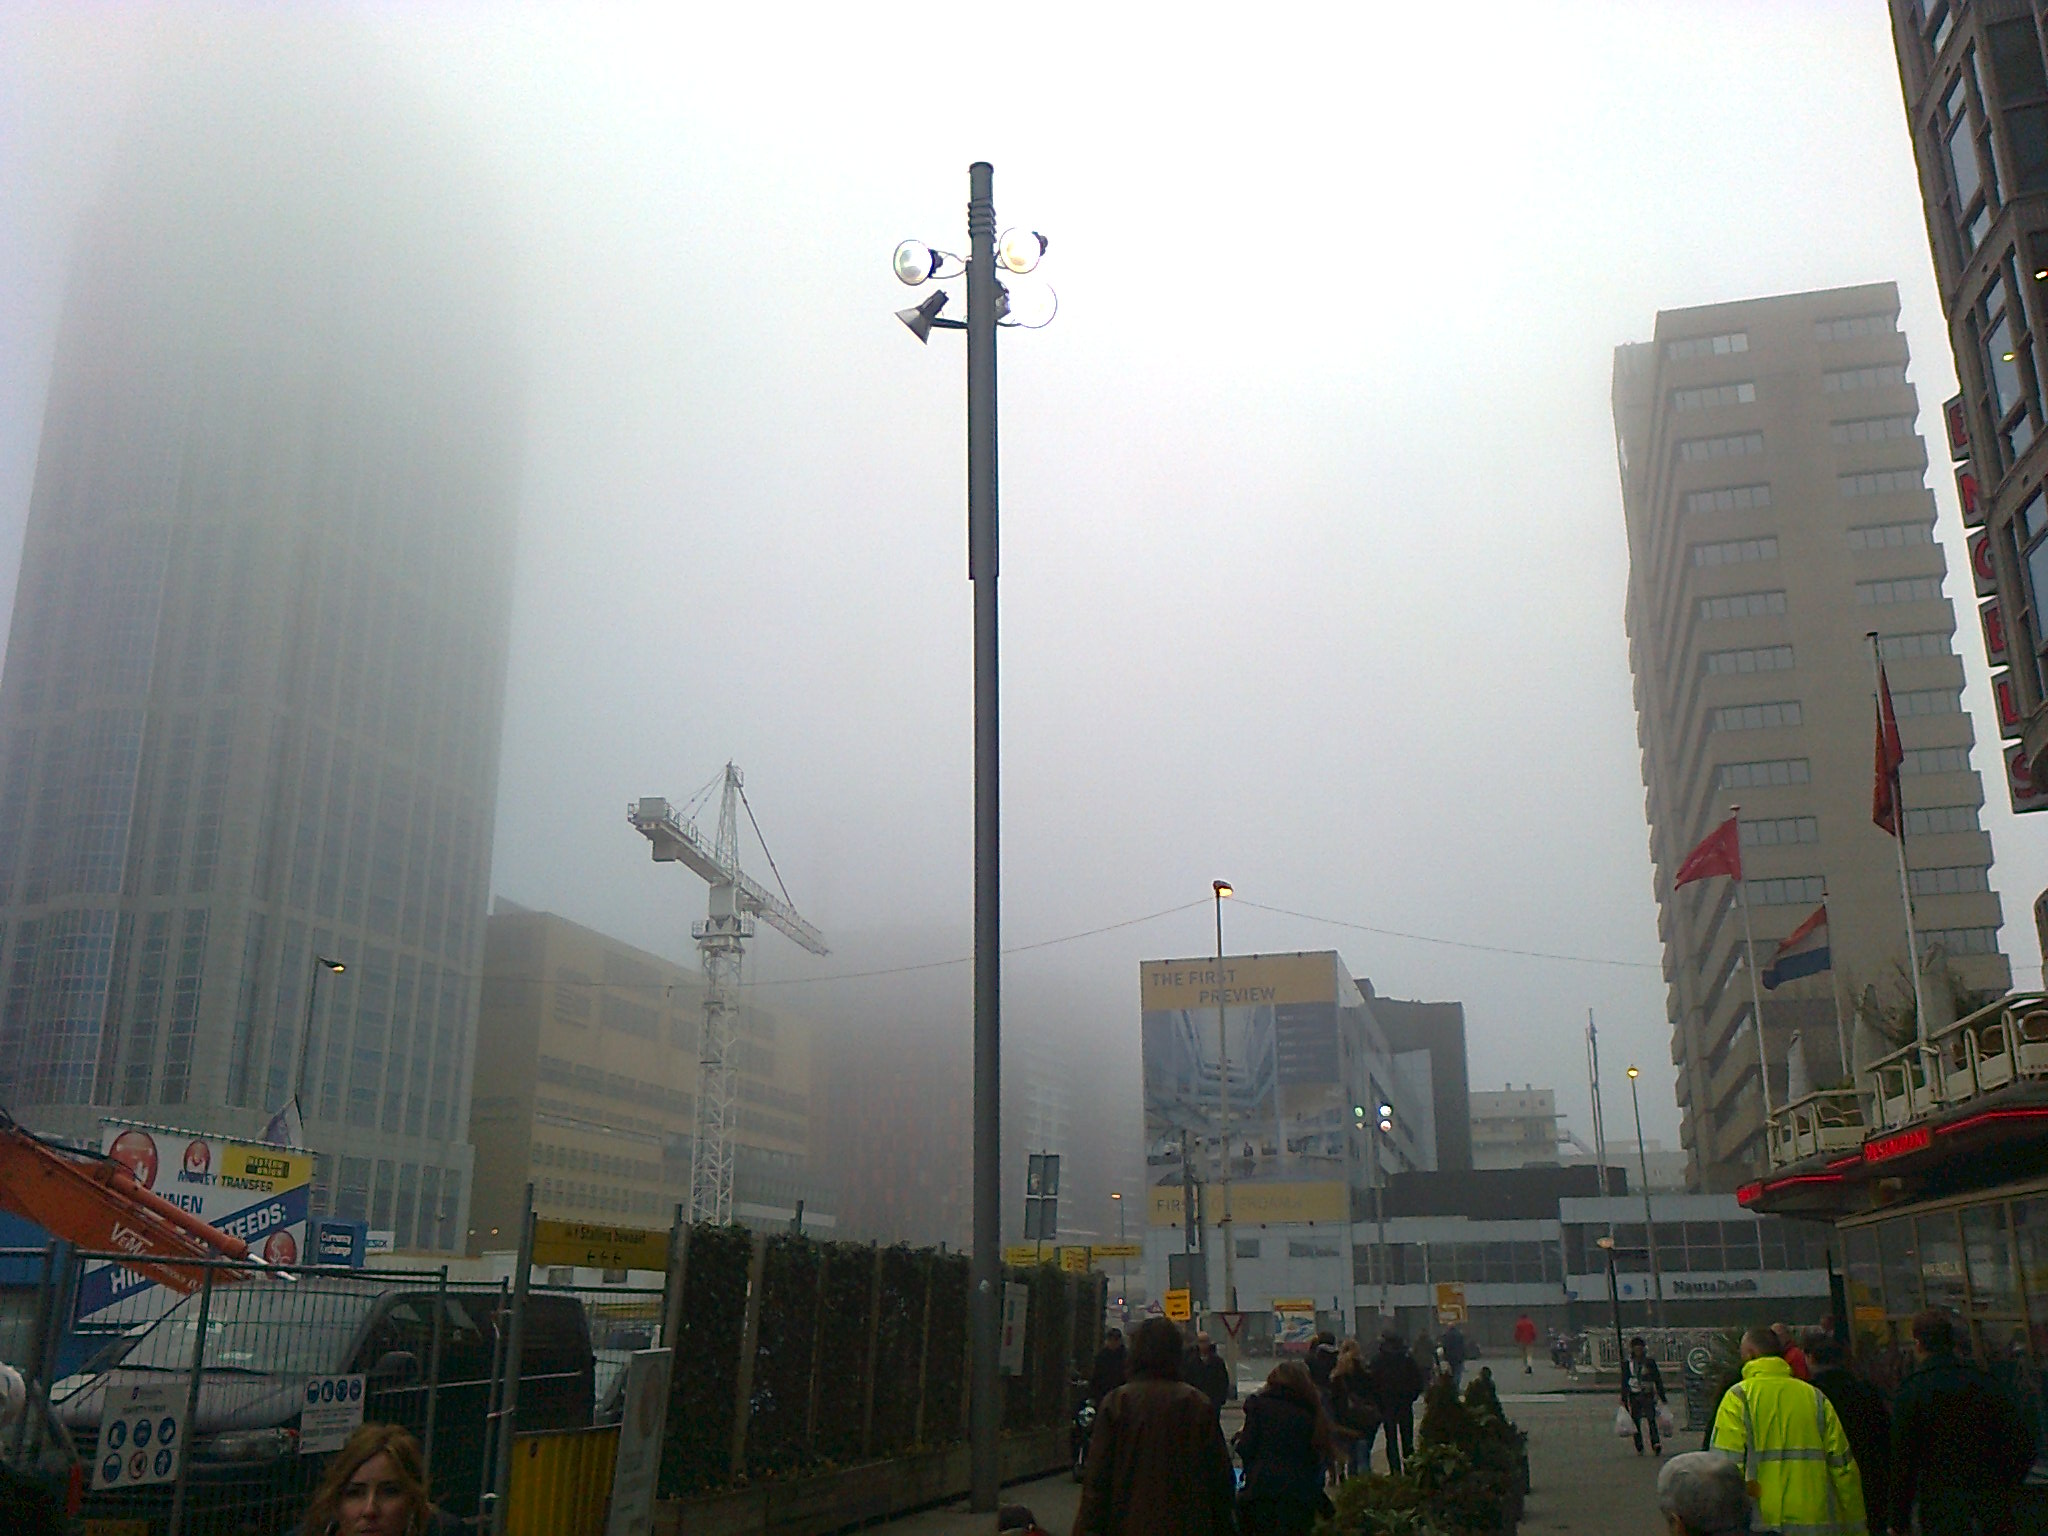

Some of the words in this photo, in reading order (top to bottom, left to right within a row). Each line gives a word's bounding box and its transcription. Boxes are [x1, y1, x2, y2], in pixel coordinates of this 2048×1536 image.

[1152, 973, 1184, 986] THE
[1200, 987, 1276, 1003] PREVIEW
[222, 1175, 273, 1193] TRANSFER
